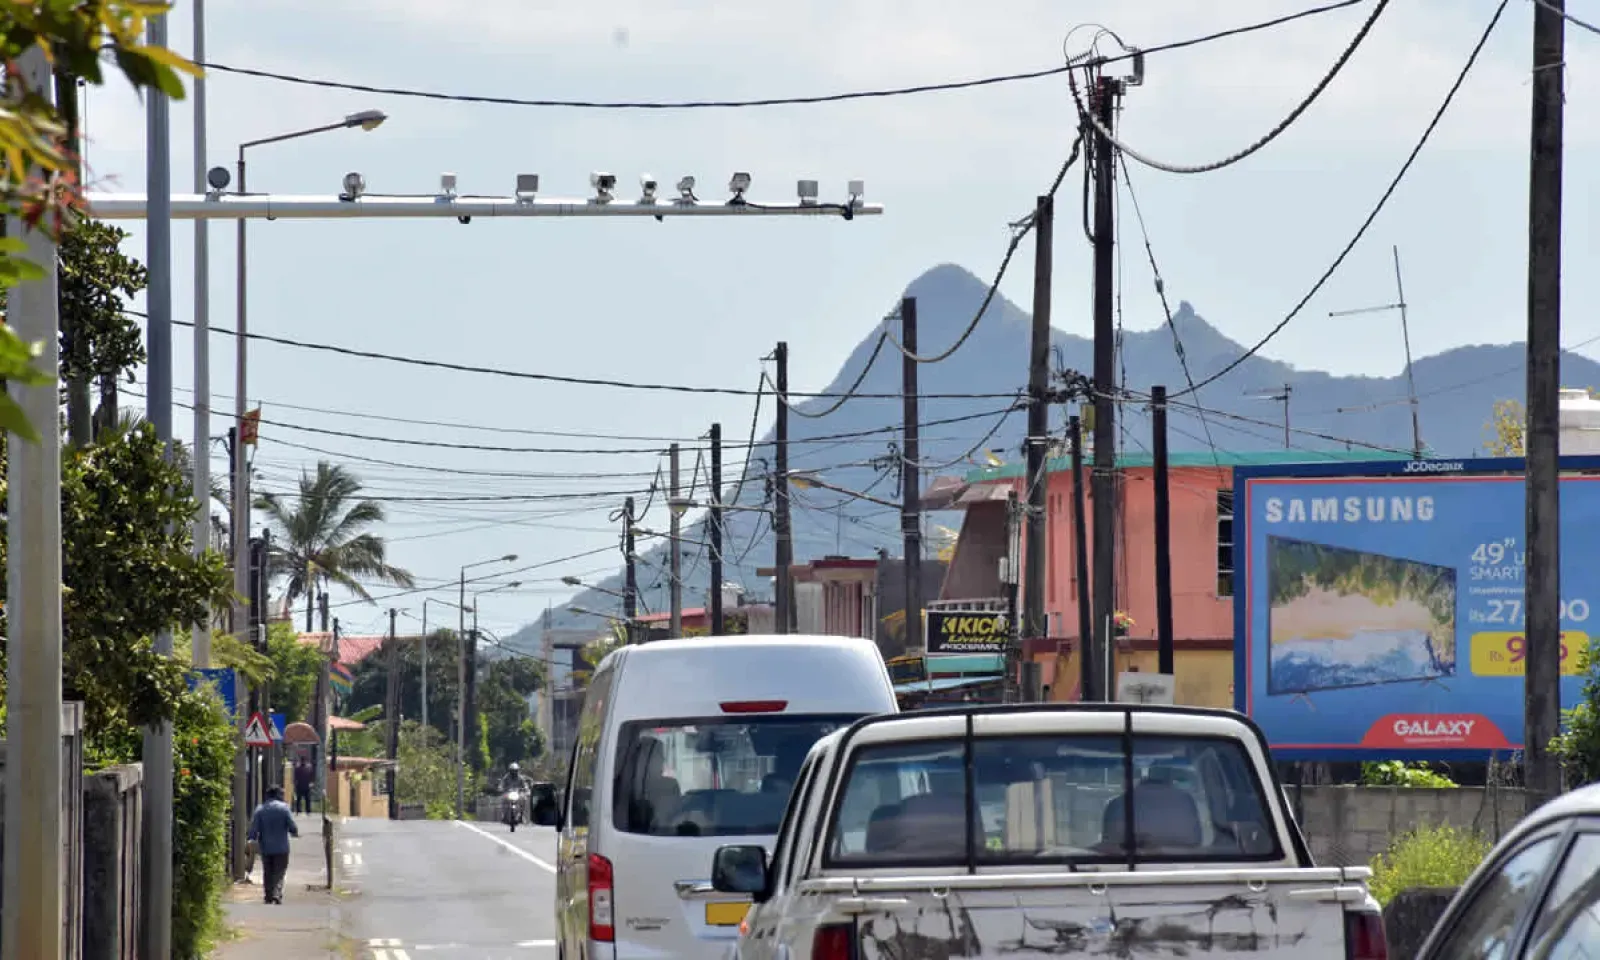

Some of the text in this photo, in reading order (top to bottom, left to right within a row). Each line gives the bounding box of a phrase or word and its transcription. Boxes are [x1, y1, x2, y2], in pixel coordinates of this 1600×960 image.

[1404, 460, 1464, 472] JCDecaux
[1265, 496, 1435, 523] SAMSUNG
[1470, 566, 1521, 580] SMART
[1393, 719, 1475, 736] GALAXY
